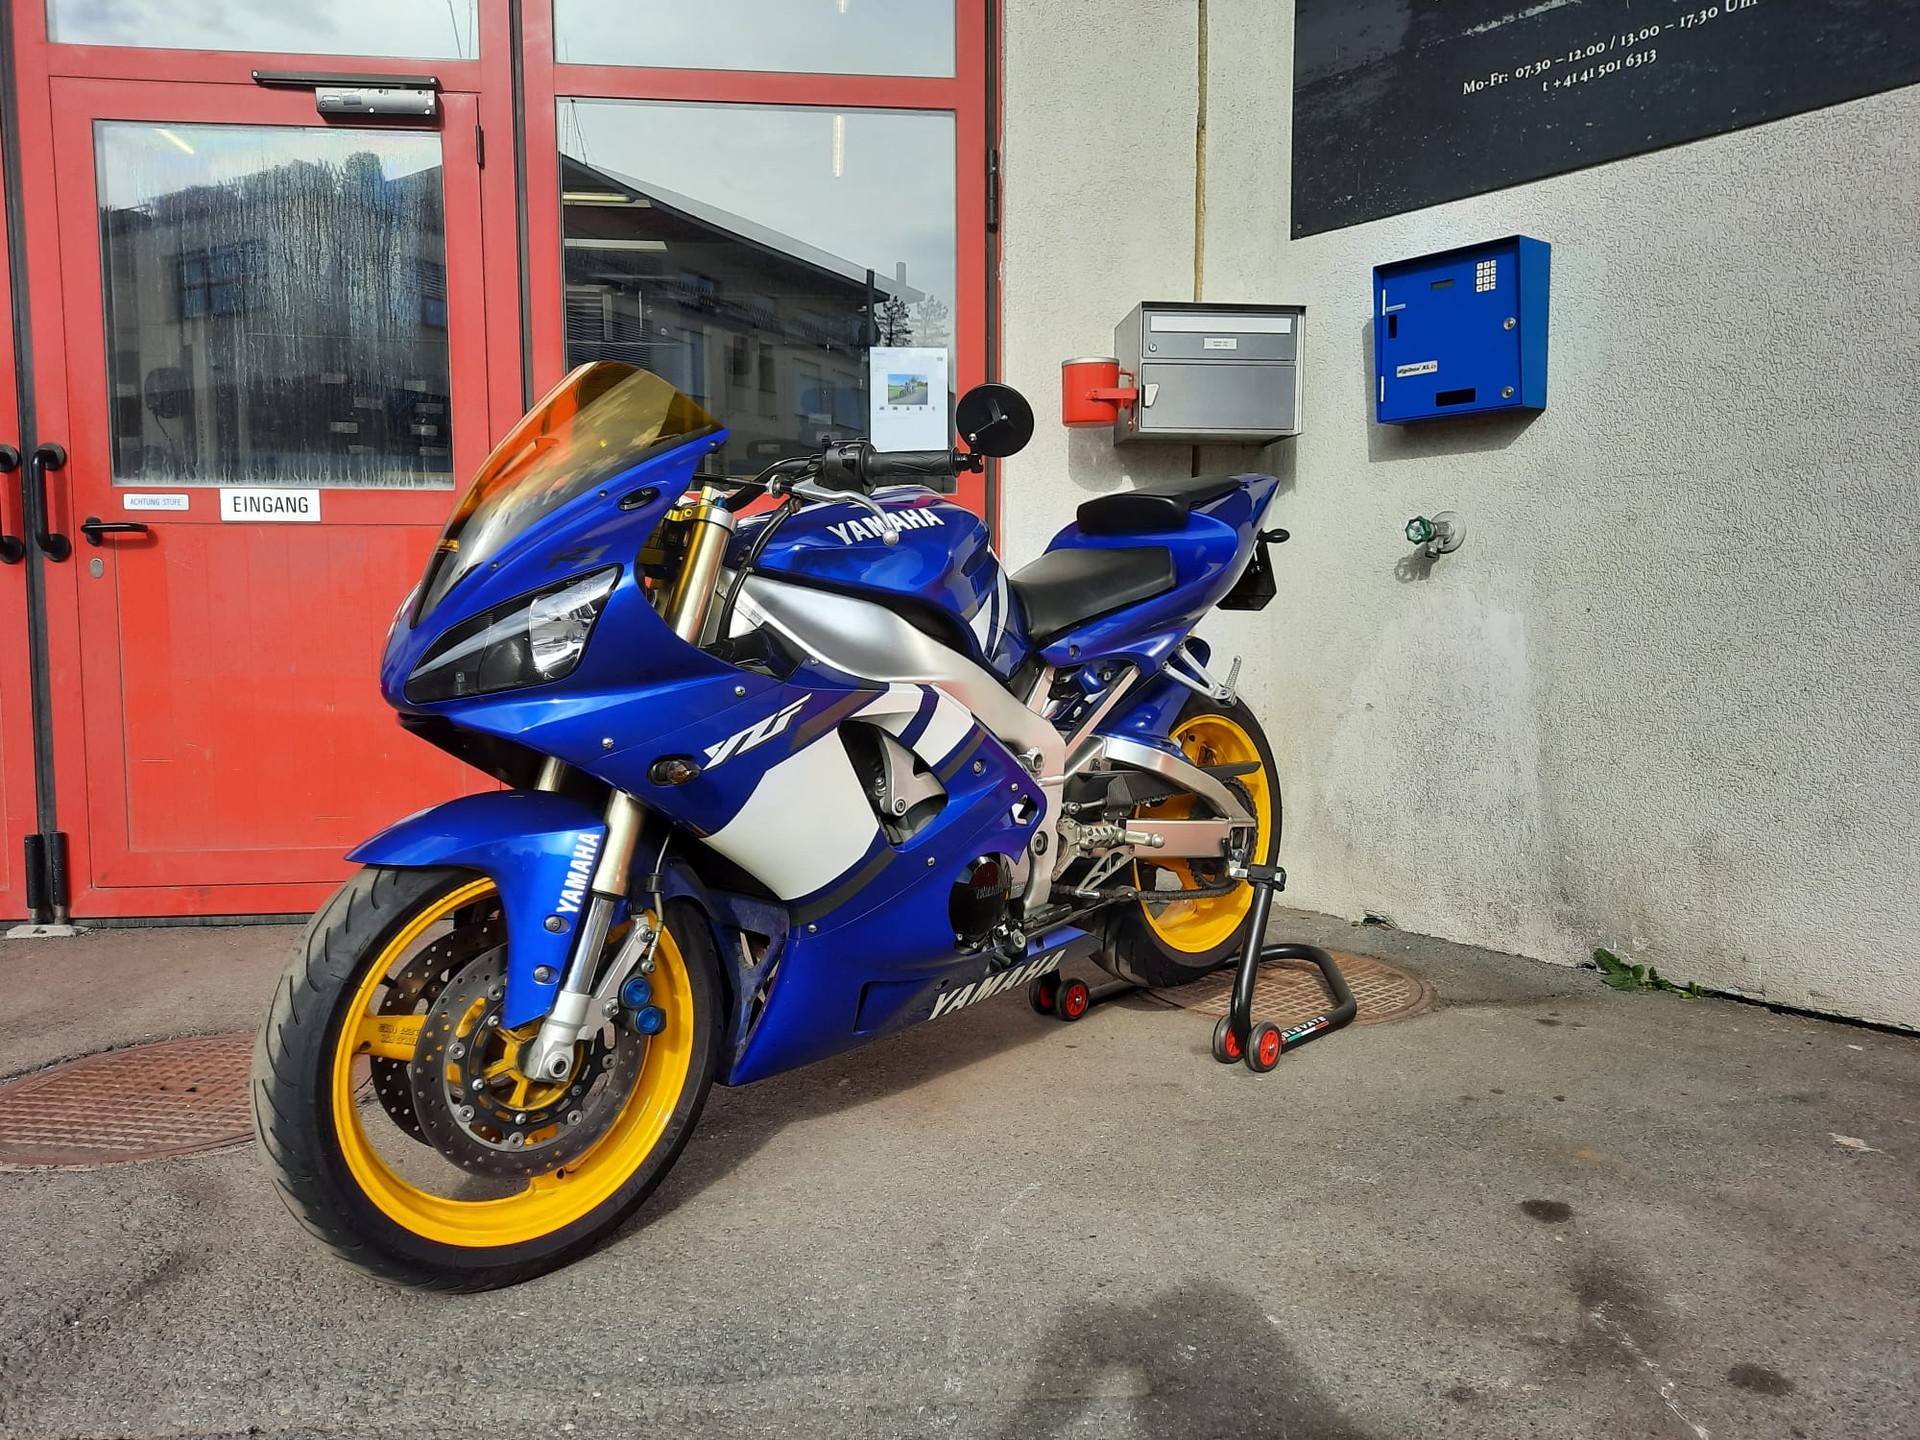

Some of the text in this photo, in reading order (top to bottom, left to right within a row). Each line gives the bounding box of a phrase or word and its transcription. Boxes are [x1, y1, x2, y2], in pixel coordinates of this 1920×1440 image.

[1463, 71, 1509, 94] Mo-Fr:
[1515, 59, 1551, 78] 07.30
[1568, 42, 1605, 62] 12.00
[1620, 25, 1660, 47] 13.00
[1680, 6, 1719, 28] 17.30
[1598, 59, 1621, 79] 501
[1625, 49, 1657, 68] 6313
[130, 497, 182, 507] ACHTUNG STUFE
[233, 496, 309, 514] EINGANG
[826, 508, 945, 546] YAMAHA
[556, 833, 600, 913] YAMAHA
[928, 949, 1067, 1021] YAMAHA
